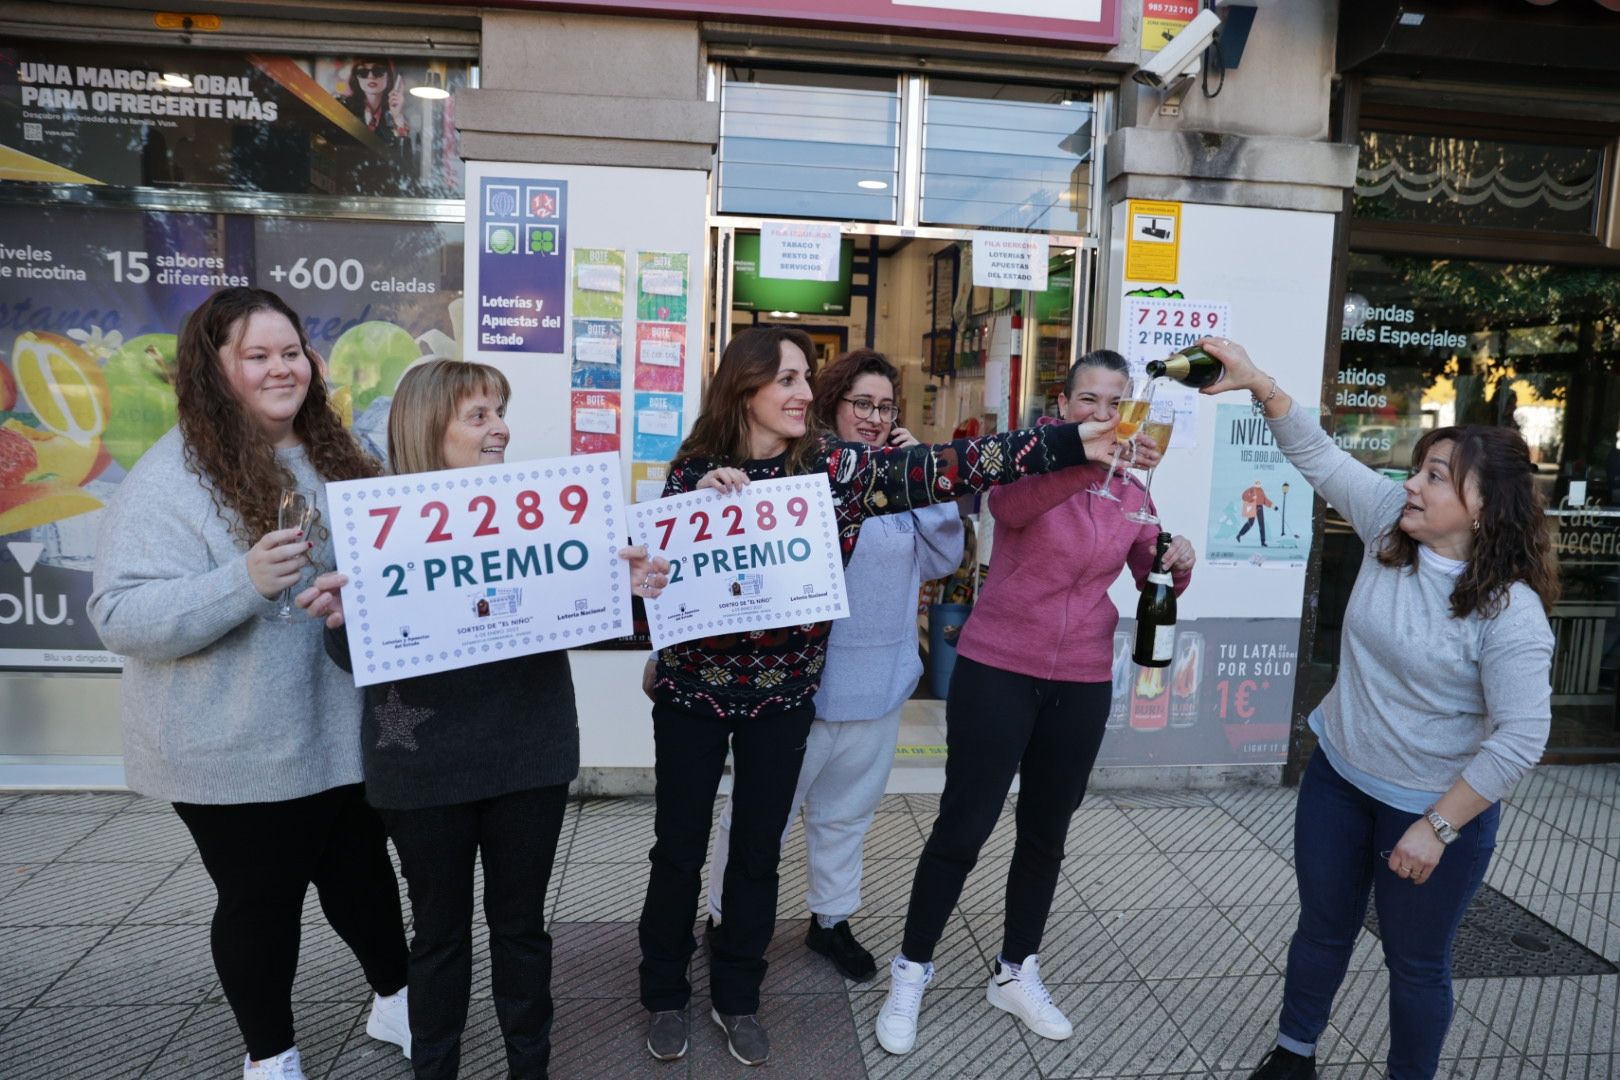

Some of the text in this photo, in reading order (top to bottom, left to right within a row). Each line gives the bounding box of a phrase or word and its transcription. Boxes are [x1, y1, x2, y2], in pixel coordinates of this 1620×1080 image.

[20, 62, 73, 85] UNA
[76, 66, 163, 91] MARCA
[21, 86, 278, 121] PARA OFRECERTE MÁS
[781, 241, 813, 249] TABACO
[984, 240, 1001, 248] FILA
[156, 252, 224, 269] sabores
[589, 250, 609, 261] BOTE
[782, 252, 807, 260] RESTO
[16, 263, 87, 281] nicotina
[106, 251, 151, 284] 15
[780, 263, 822, 271] SERVICIOS
[991, 262, 1029, 270] APUESTAS
[156, 269, 249, 287] diferentes
[269, 257, 436, 294] +600 caladas
[987, 271, 1032, 281] DEL ESTADO
[482, 295, 543, 311] Loterías y
[481, 314, 561, 328] Apuestas del
[1138, 308, 1218, 329] 72289
[481, 332, 524, 345] Estado
[587, 325, 607, 335] BOTE
[1379, 325, 1467, 348] Especiales
[1337, 368, 1386, 386] atidos
[586, 394, 606, 405] BOTE
[368, 484, 589, 550] 72289
[1558, 495, 1602, 527] Café
[655, 496, 809, 551] 72289
[692, 537, 811, 577] PREMIO
[423, 540, 589, 592] PREMIO
[457, 624, 485, 634] SORTEO
[487, 622, 496, 630] DE
[1220, 644, 1236, 659] TU
[1243, 644, 1277, 659] LATA
[1217, 658, 1291, 676] POR SÓLO
